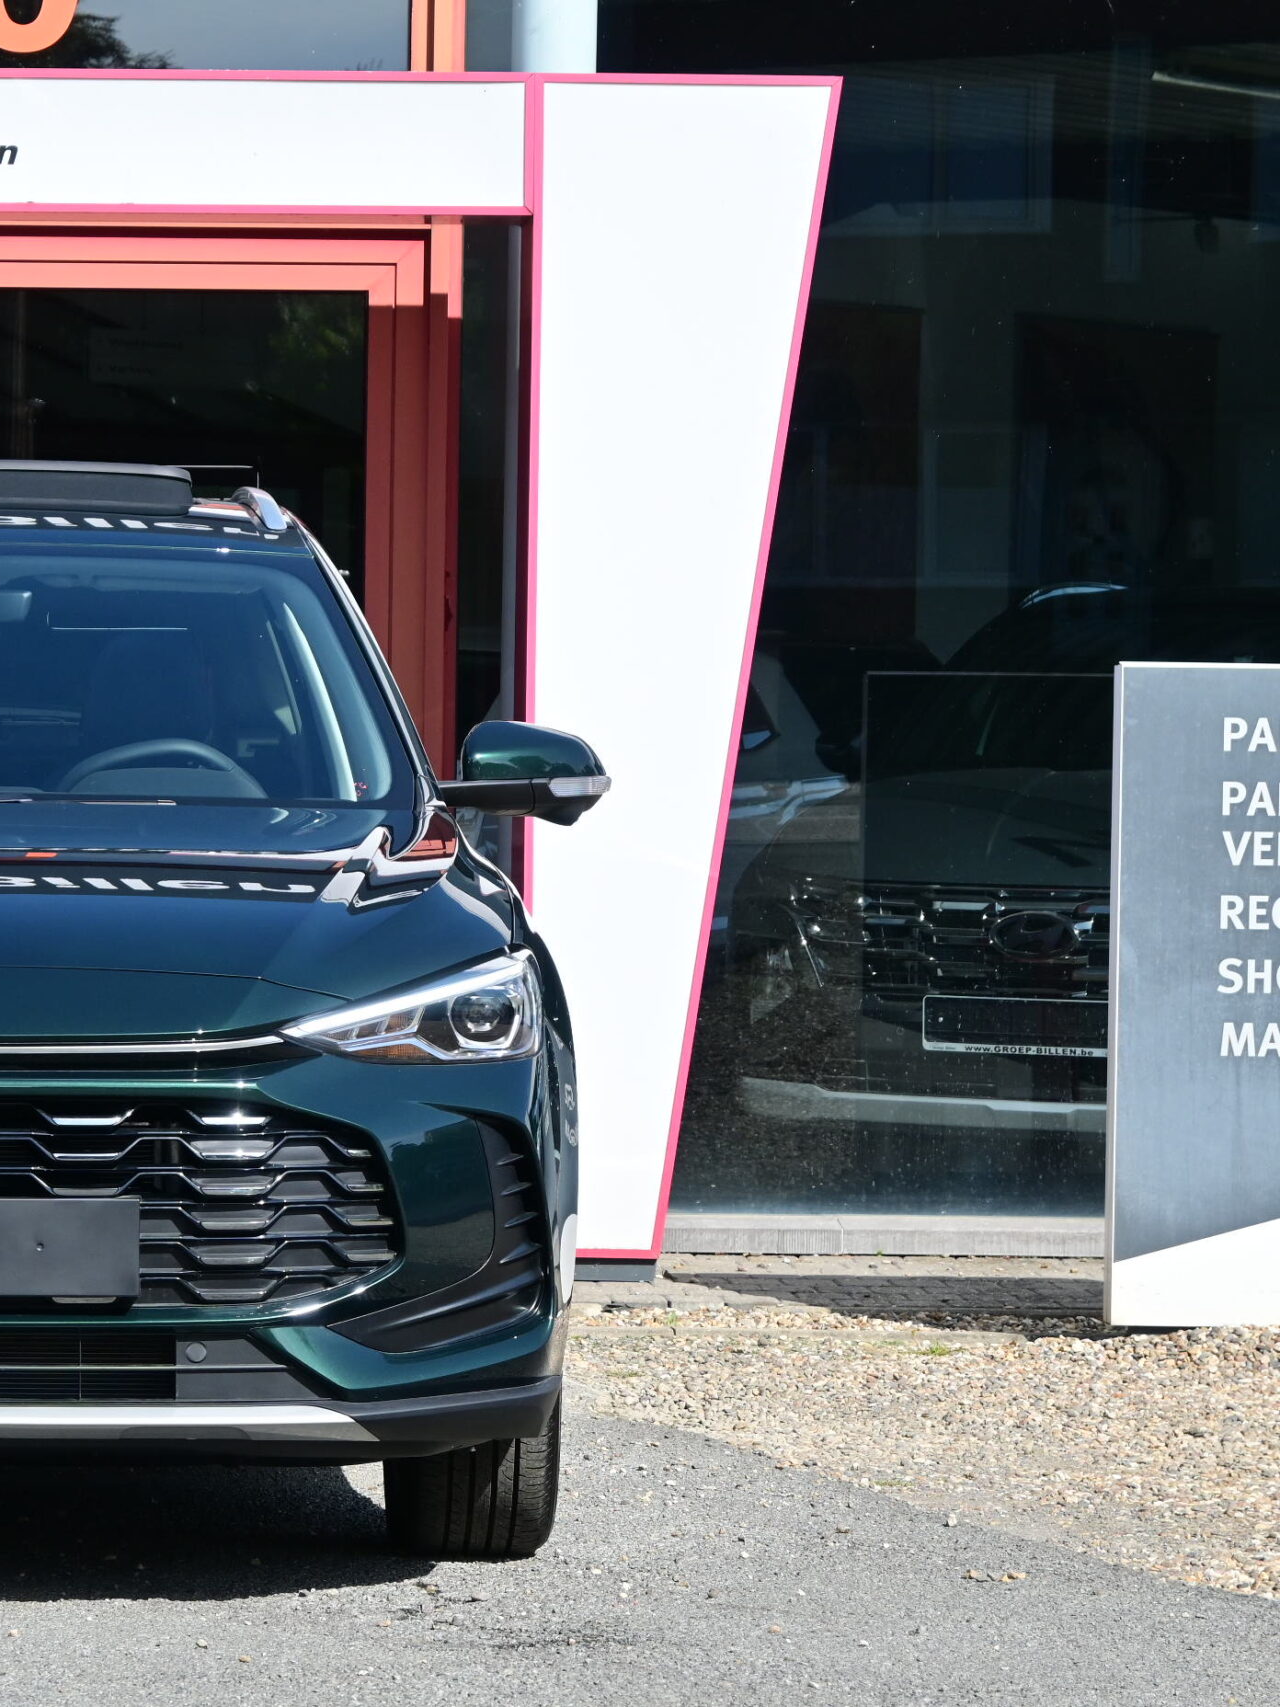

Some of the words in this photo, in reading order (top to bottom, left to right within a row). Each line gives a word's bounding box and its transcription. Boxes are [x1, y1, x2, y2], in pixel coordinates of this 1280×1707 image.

[1223, 716, 1278, 753] PA
[1221, 780, 1280, 817] PA
[1221, 830, 1280, 867] VE
[1216, 957, 1280, 995] SH
[964, 1043, 1094, 1057] www.GROEP-BILLEN.be
